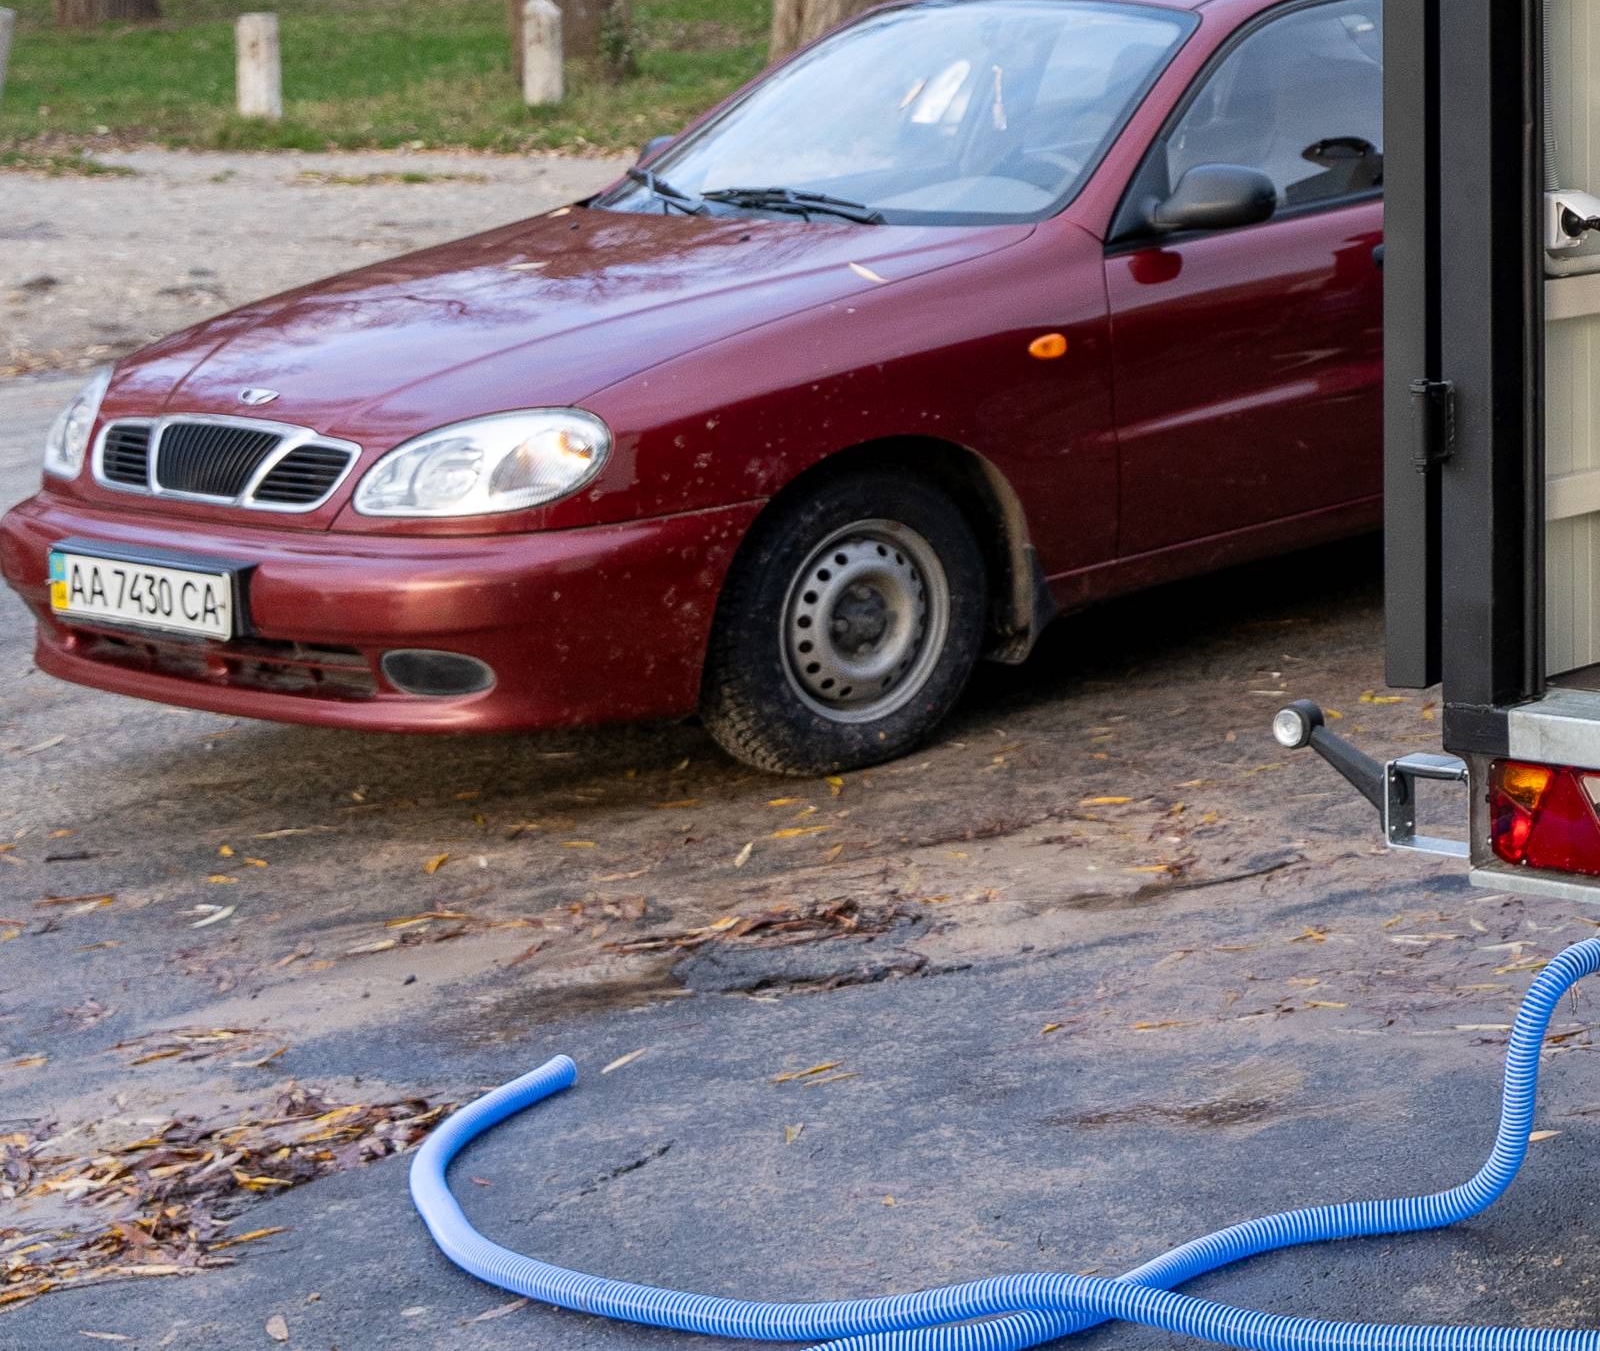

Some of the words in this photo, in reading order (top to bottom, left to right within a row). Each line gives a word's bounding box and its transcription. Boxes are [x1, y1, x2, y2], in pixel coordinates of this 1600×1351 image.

[70, 564, 107, 607] AA
[113, 570, 173, 617] 7430
[181, 581, 220, 625] CA
